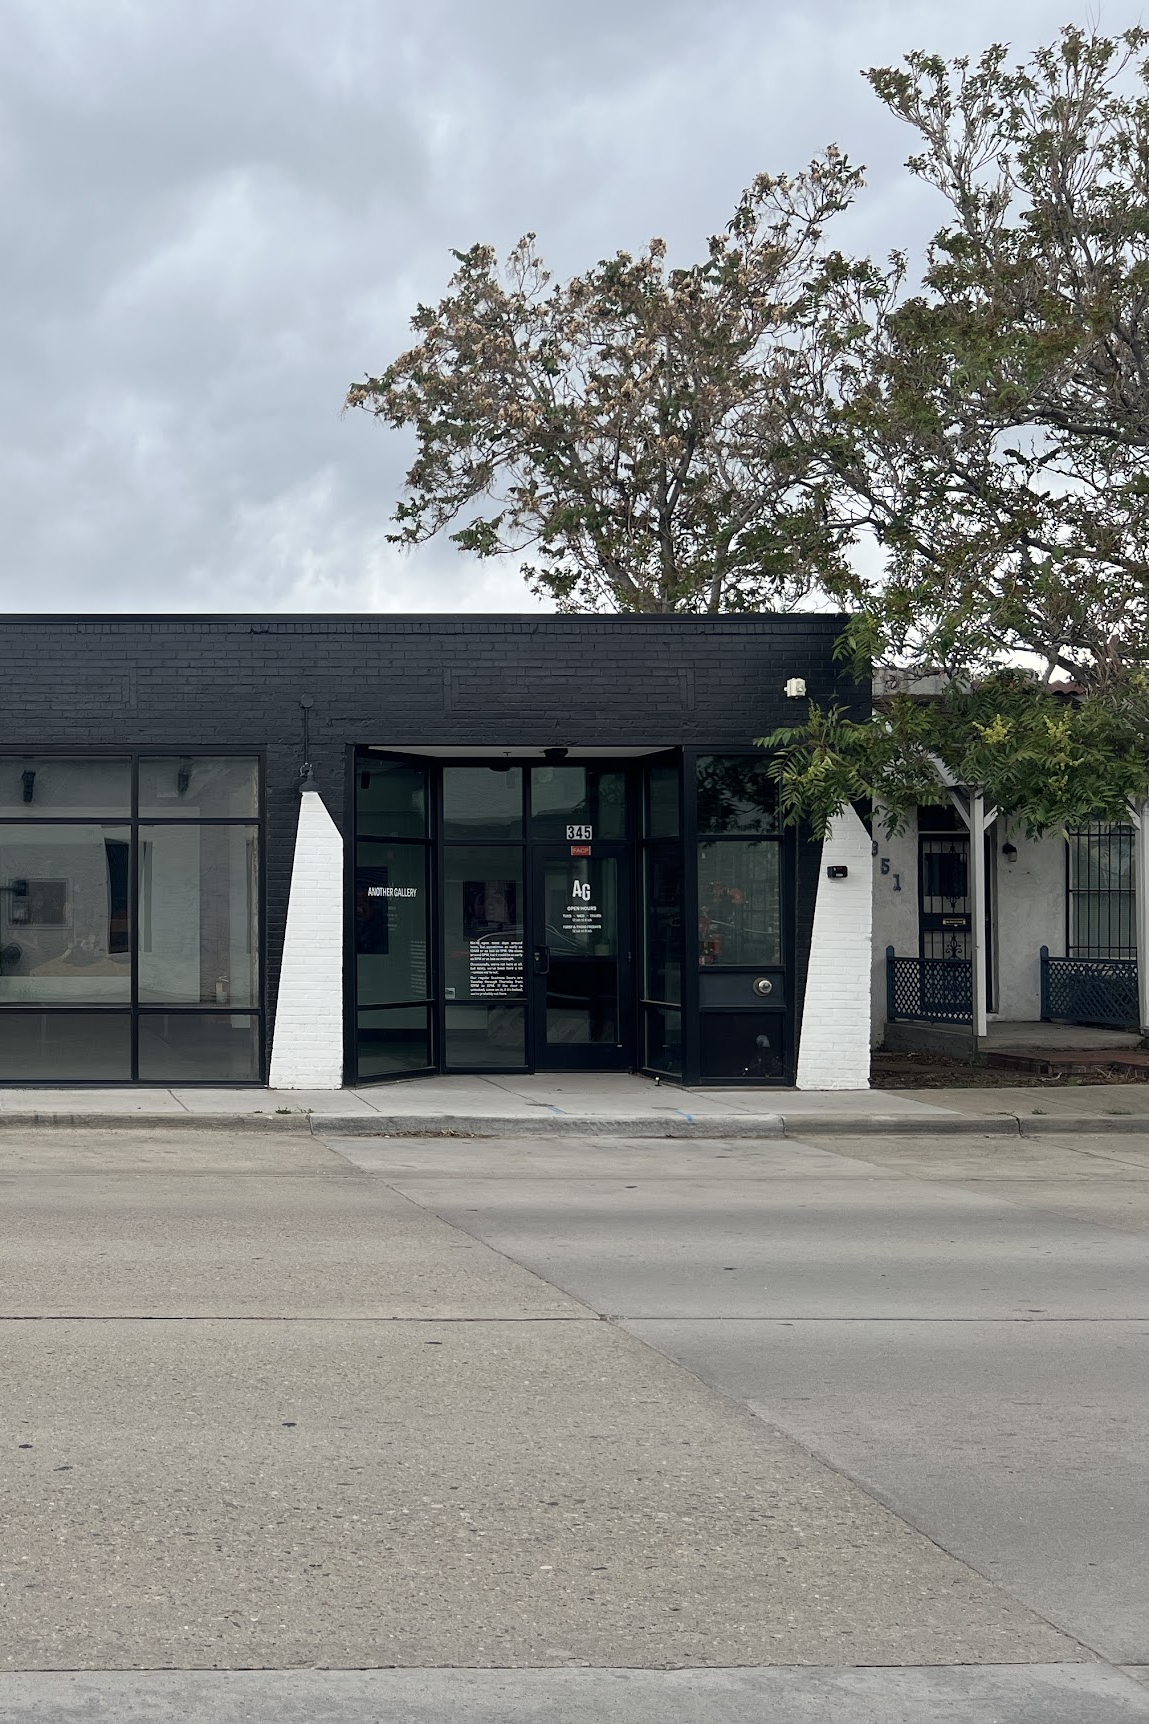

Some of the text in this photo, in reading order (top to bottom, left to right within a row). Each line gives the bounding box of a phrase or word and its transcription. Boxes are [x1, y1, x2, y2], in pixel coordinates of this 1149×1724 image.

[568, 826, 591, 839] 345
[368, 886, 417, 897] ANOTHER GALLERY
